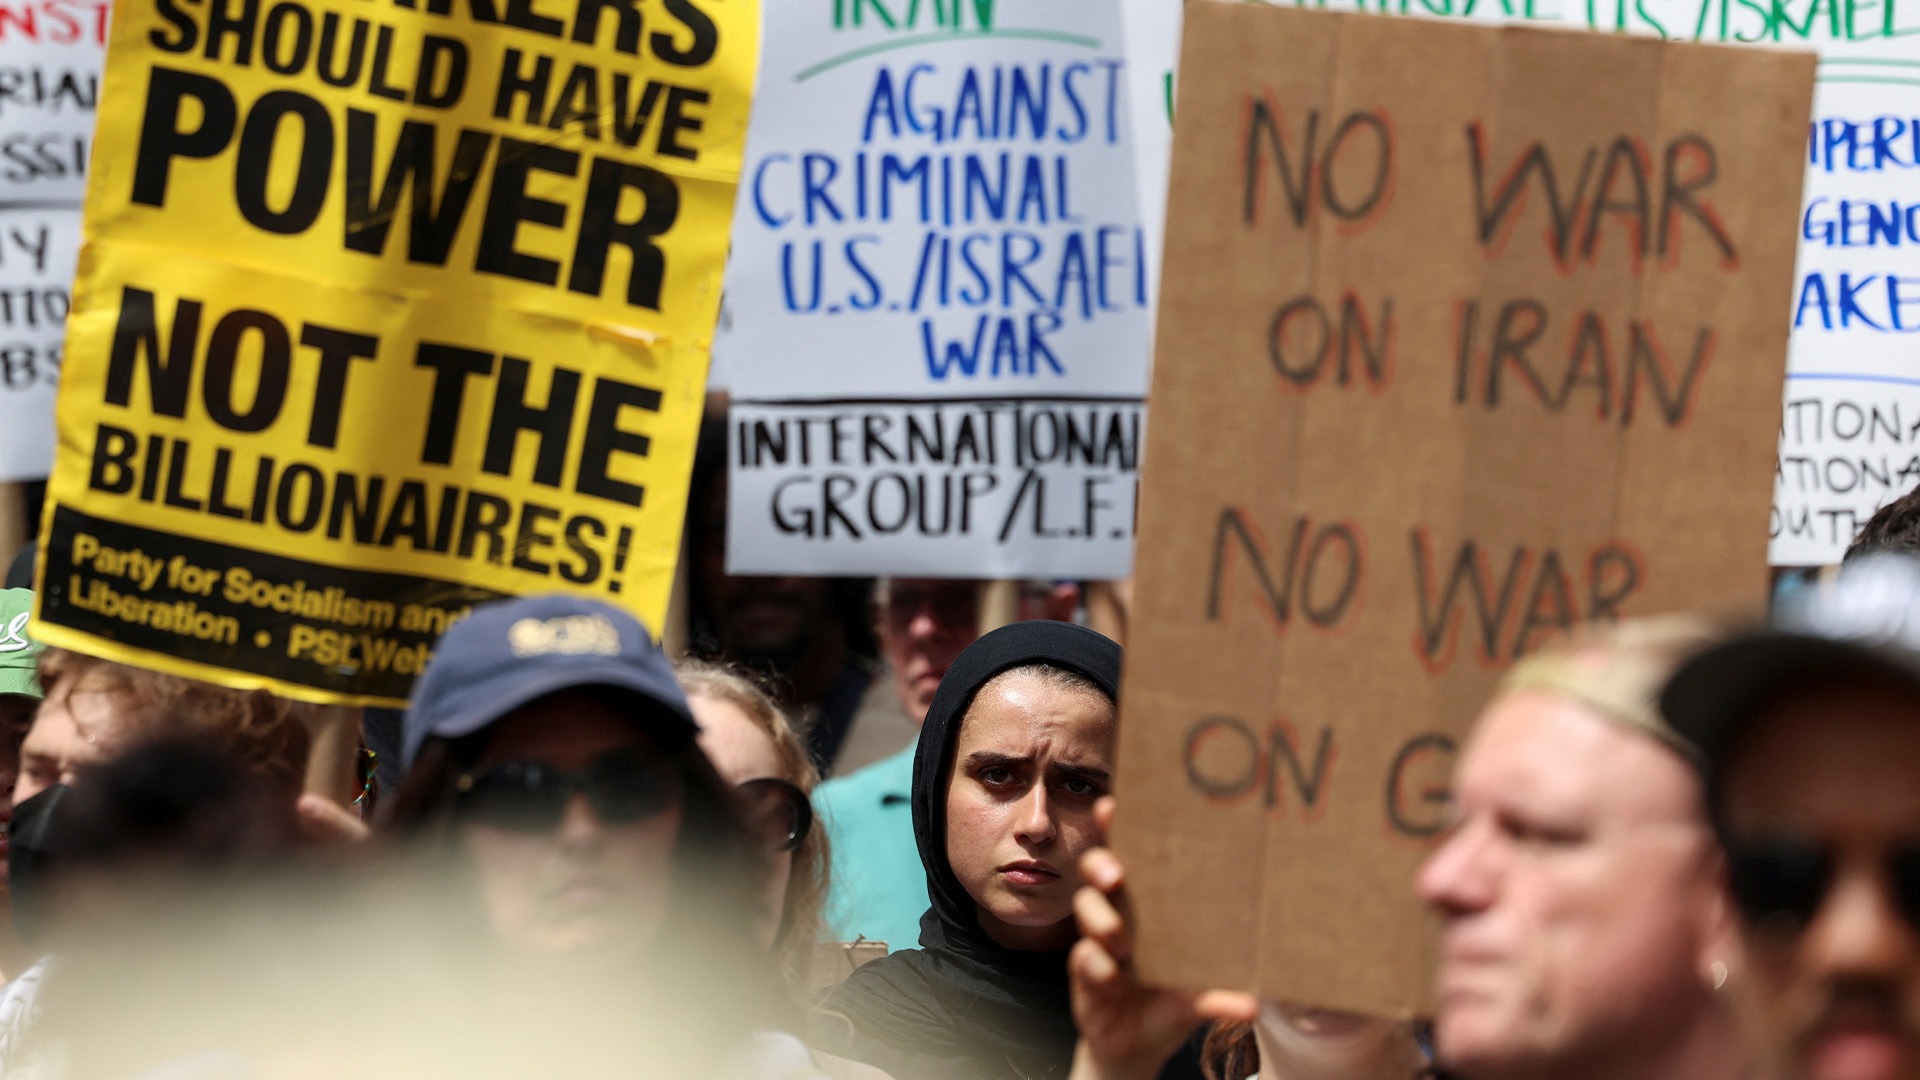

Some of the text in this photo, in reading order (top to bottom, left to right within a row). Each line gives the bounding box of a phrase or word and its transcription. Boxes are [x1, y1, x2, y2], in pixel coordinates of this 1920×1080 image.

[150, 0, 710, 161] SHOULD HAVE
[863, 58, 1125, 145] AGAINST
[130, 65, 681, 313] POWER
[752, 152, 1086, 228] CRIMINAL
[1242, 90, 1740, 272] NO WAR
[103, 285, 664, 507] NOT THE
[922, 313, 1065, 380] WAR
[1268, 292, 1715, 428] ON IRAN
[89, 424, 632, 592] BILLIONAIRES!
[68, 573, 240, 646] Liberation
[71, 532, 164, 592] Party
[168, 555, 221, 596] for
[223, 566, 397, 630] Socialism
[1206, 507, 1645, 672] NO WAR
[1184, 716, 1336, 820] ON
